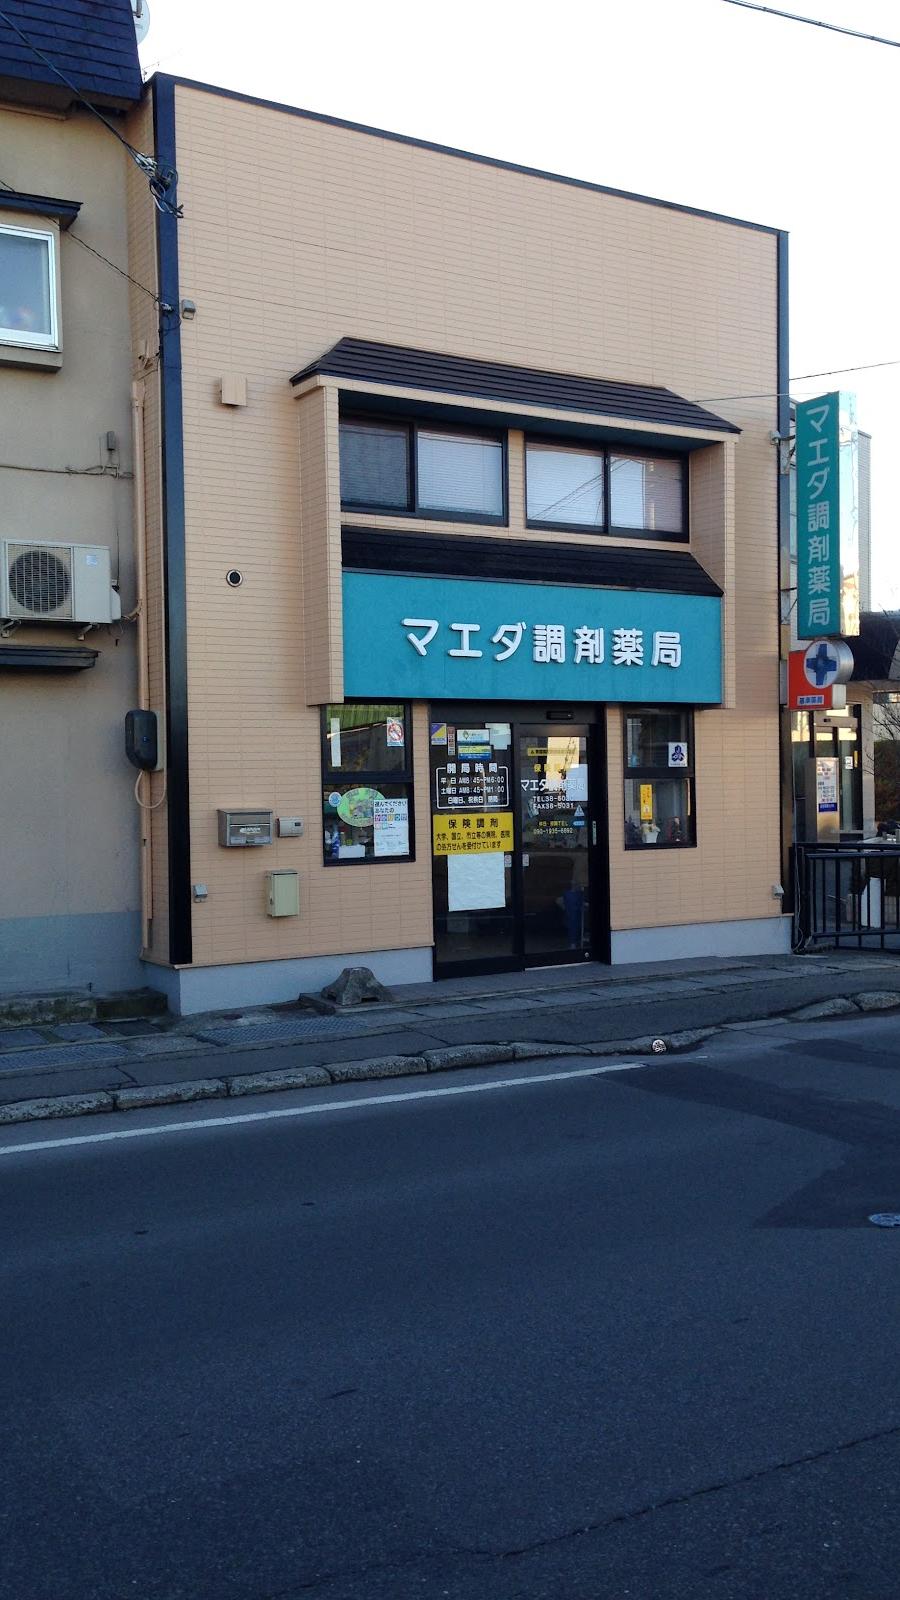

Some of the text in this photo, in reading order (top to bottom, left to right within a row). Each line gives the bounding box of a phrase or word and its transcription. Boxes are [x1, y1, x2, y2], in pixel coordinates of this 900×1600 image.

[806, 404, 831, 627] マエダ調剤薬局
[402, 618, 682, 667] マエダ調剤薬局
[448, 818, 499, 829] 保険調剤
